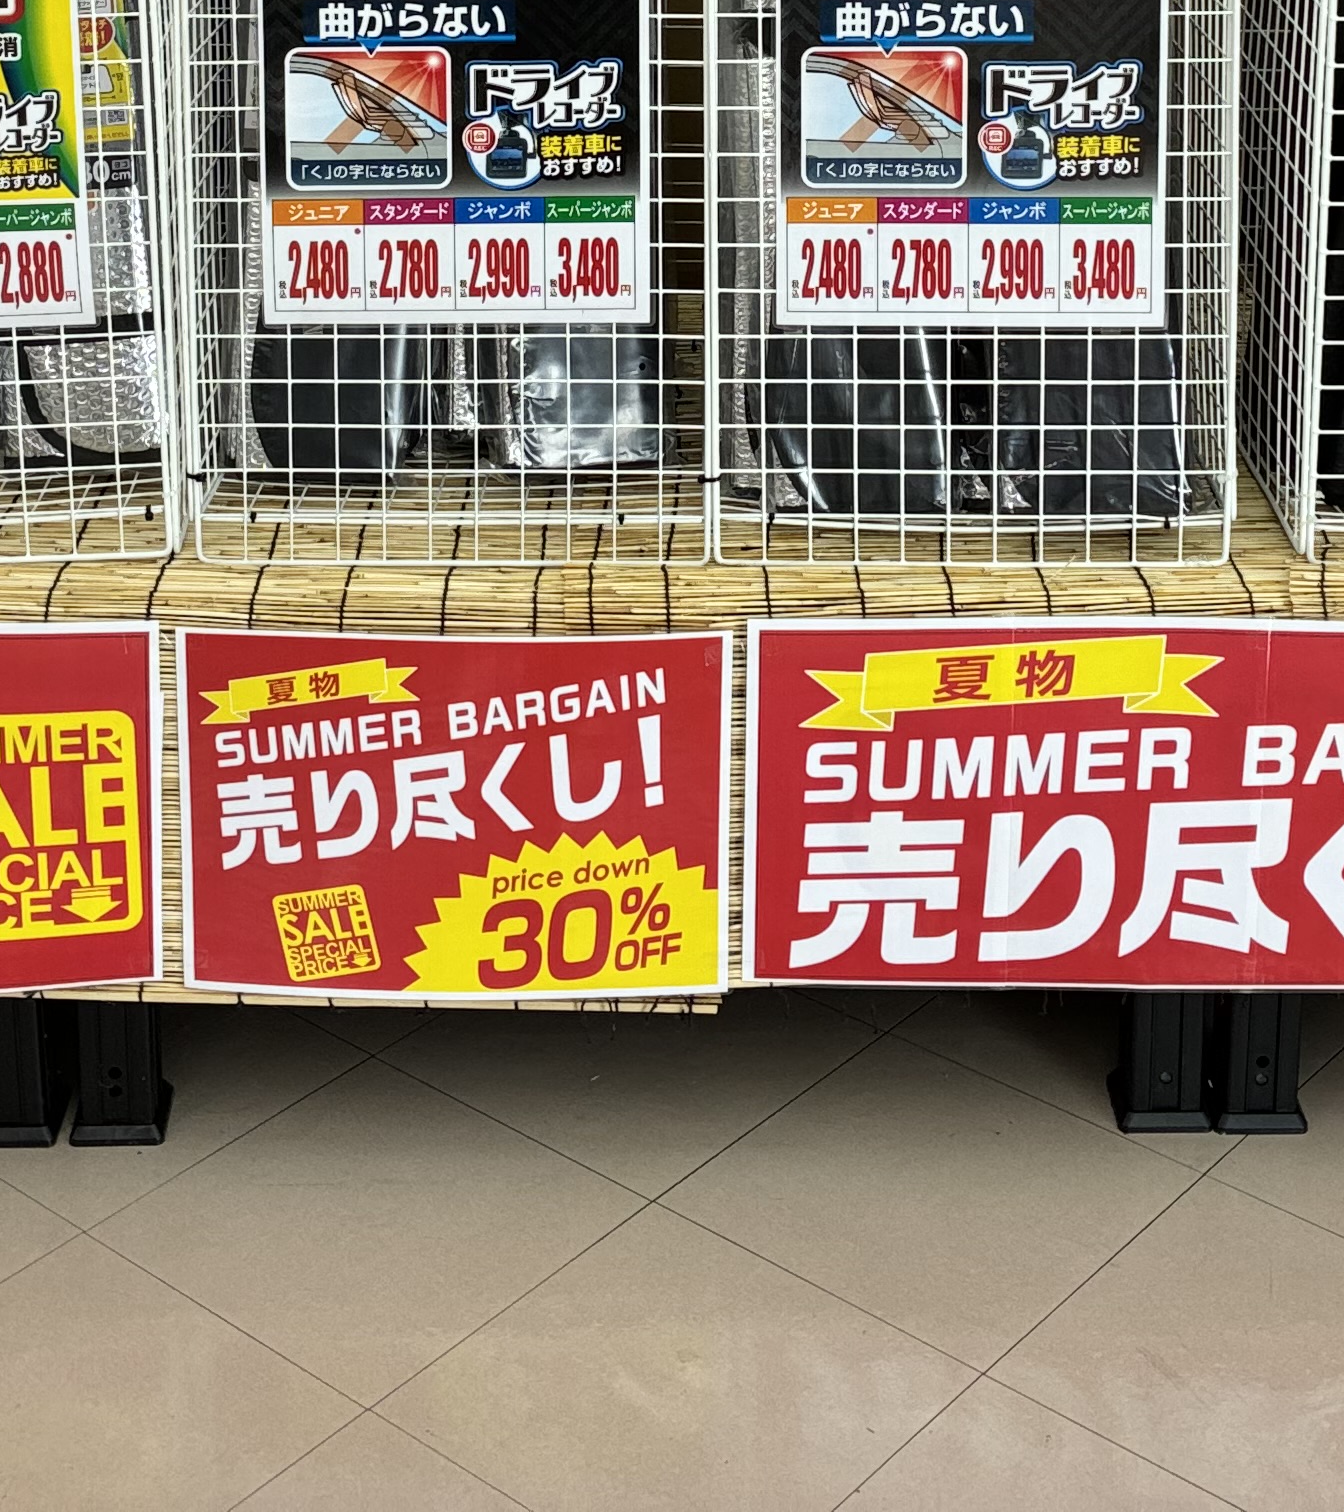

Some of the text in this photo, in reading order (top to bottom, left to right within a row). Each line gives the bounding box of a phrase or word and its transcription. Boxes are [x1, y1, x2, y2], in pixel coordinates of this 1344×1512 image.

[318, 1, 508, 39] 曲がらない
[835, 1, 1024, 39] 曲がらない
[299, 163, 442, 181] 「く」の字にならない
[1059, 157, 1139, 176] おすすめ!
[266, 672, 340, 706] 夏物
[935, 651, 1072, 700] 夏物
[215, 668, 666, 768] SUMMER BARGAIN
[805, 726, 1190, 805] SUMMER
[218, 714, 665, 870] 売り尽くし!
[493, 856, 649, 898] price down
[615, 933, 682, 972] OFF
